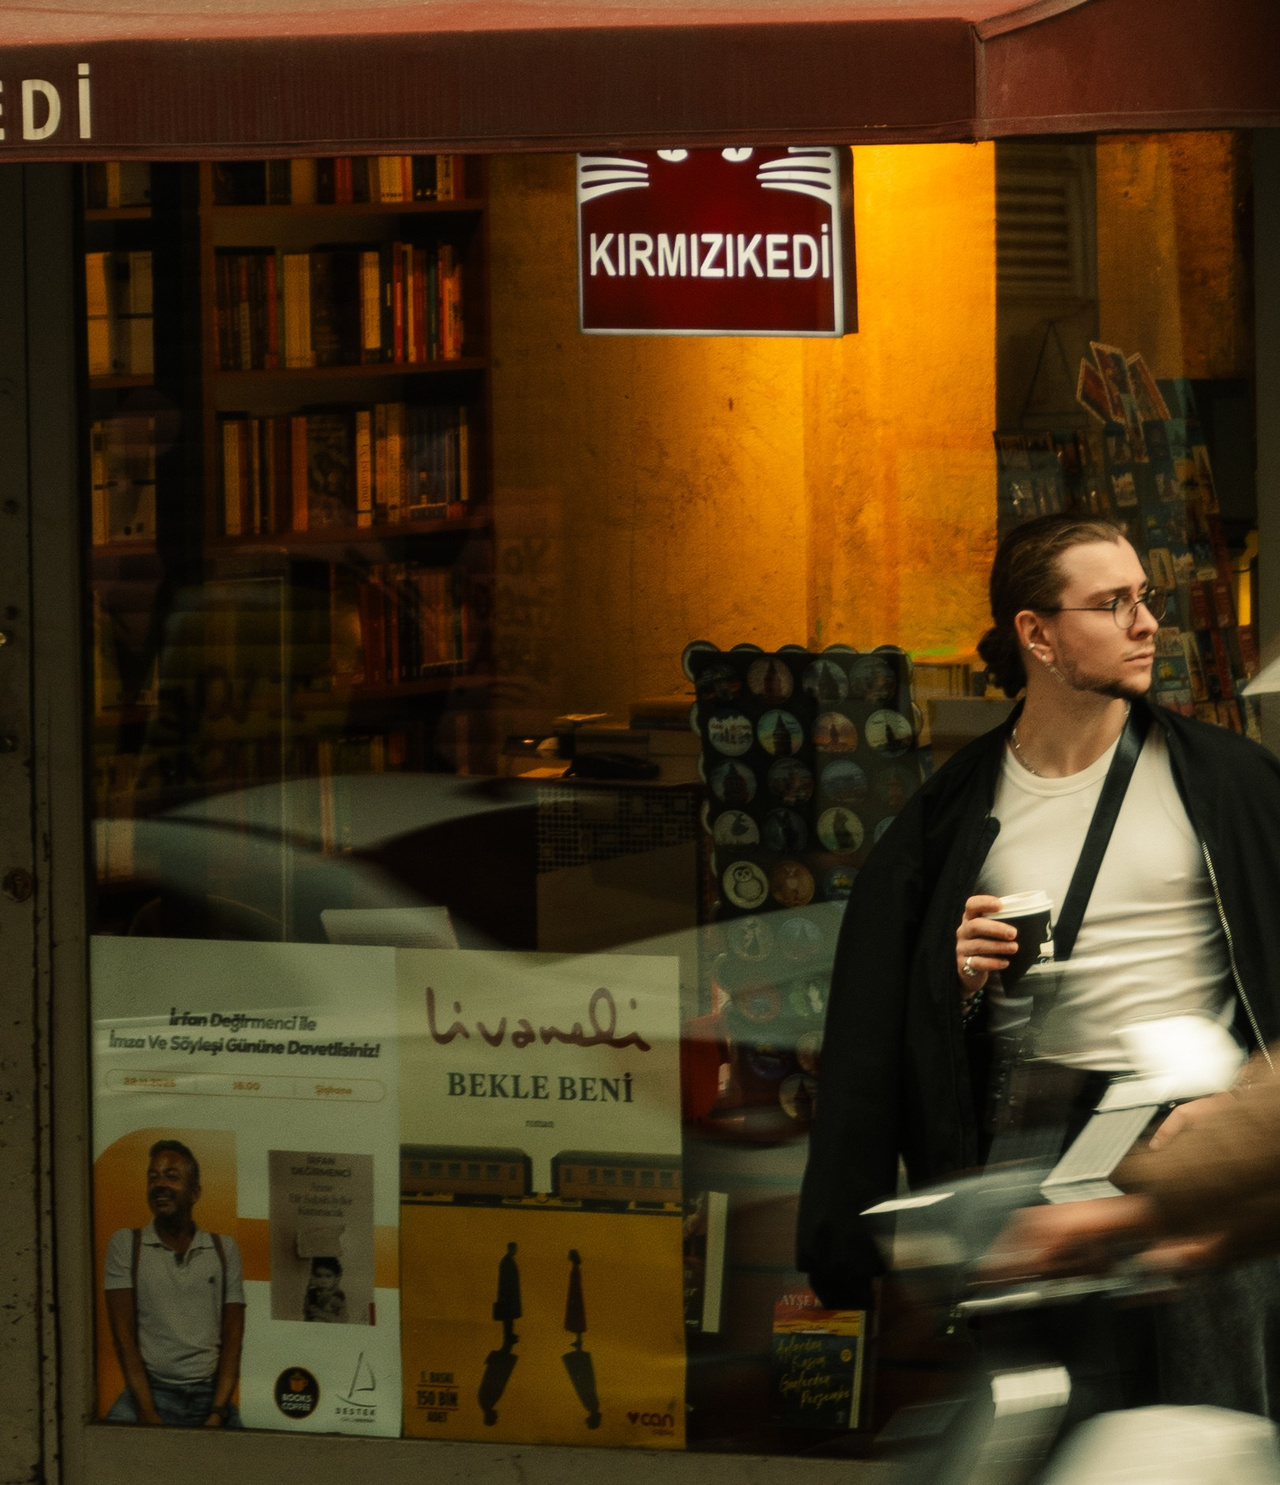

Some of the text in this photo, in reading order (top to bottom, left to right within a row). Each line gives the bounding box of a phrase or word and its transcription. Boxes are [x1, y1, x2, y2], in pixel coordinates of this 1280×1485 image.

[589, 222, 831, 279] KIRMIZIKEDİ
[169, 1007, 207, 1026] İrfan
[210, 1013, 298, 1033] Değirmenci
[109, 1030, 380, 1058] İmza Ve Söyleşi Gününe Davetlisiniz!
[447, 1072, 634, 1103] BEKLE BENİ
[525, 1120, 555, 1129] roman
[281, 1393, 312, 1402] BOOKS
[417, 1390, 435, 1406] 150
[641, 1412, 675, 1428] can
